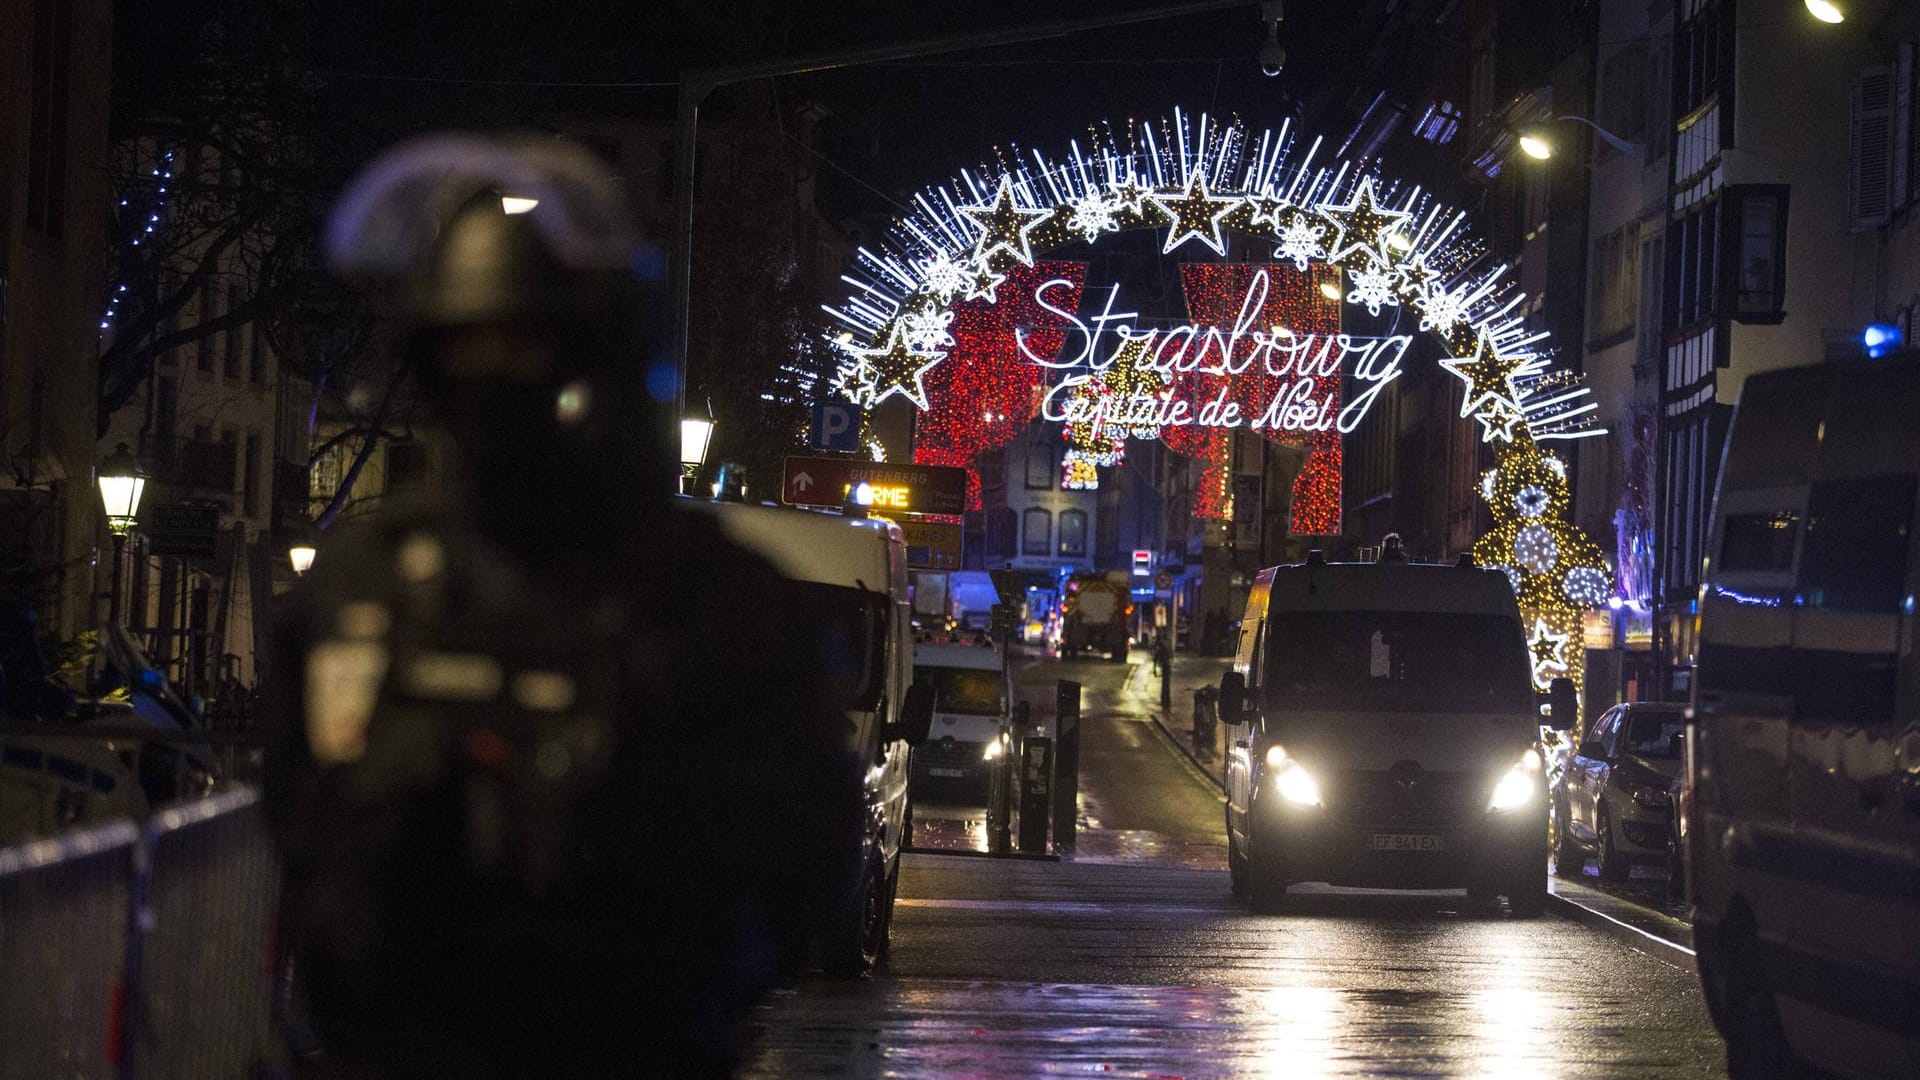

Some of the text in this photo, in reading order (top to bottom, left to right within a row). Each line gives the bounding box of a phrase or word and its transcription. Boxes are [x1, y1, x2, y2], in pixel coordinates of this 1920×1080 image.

[1015, 269, 1413, 434] Strasbourg
[821, 406, 849, 446] P
[1042, 373, 1334, 441] Capitale de Noël
[850, 468, 928, 485] GUTENBERG
[905, 529, 946, 543] KINGS
